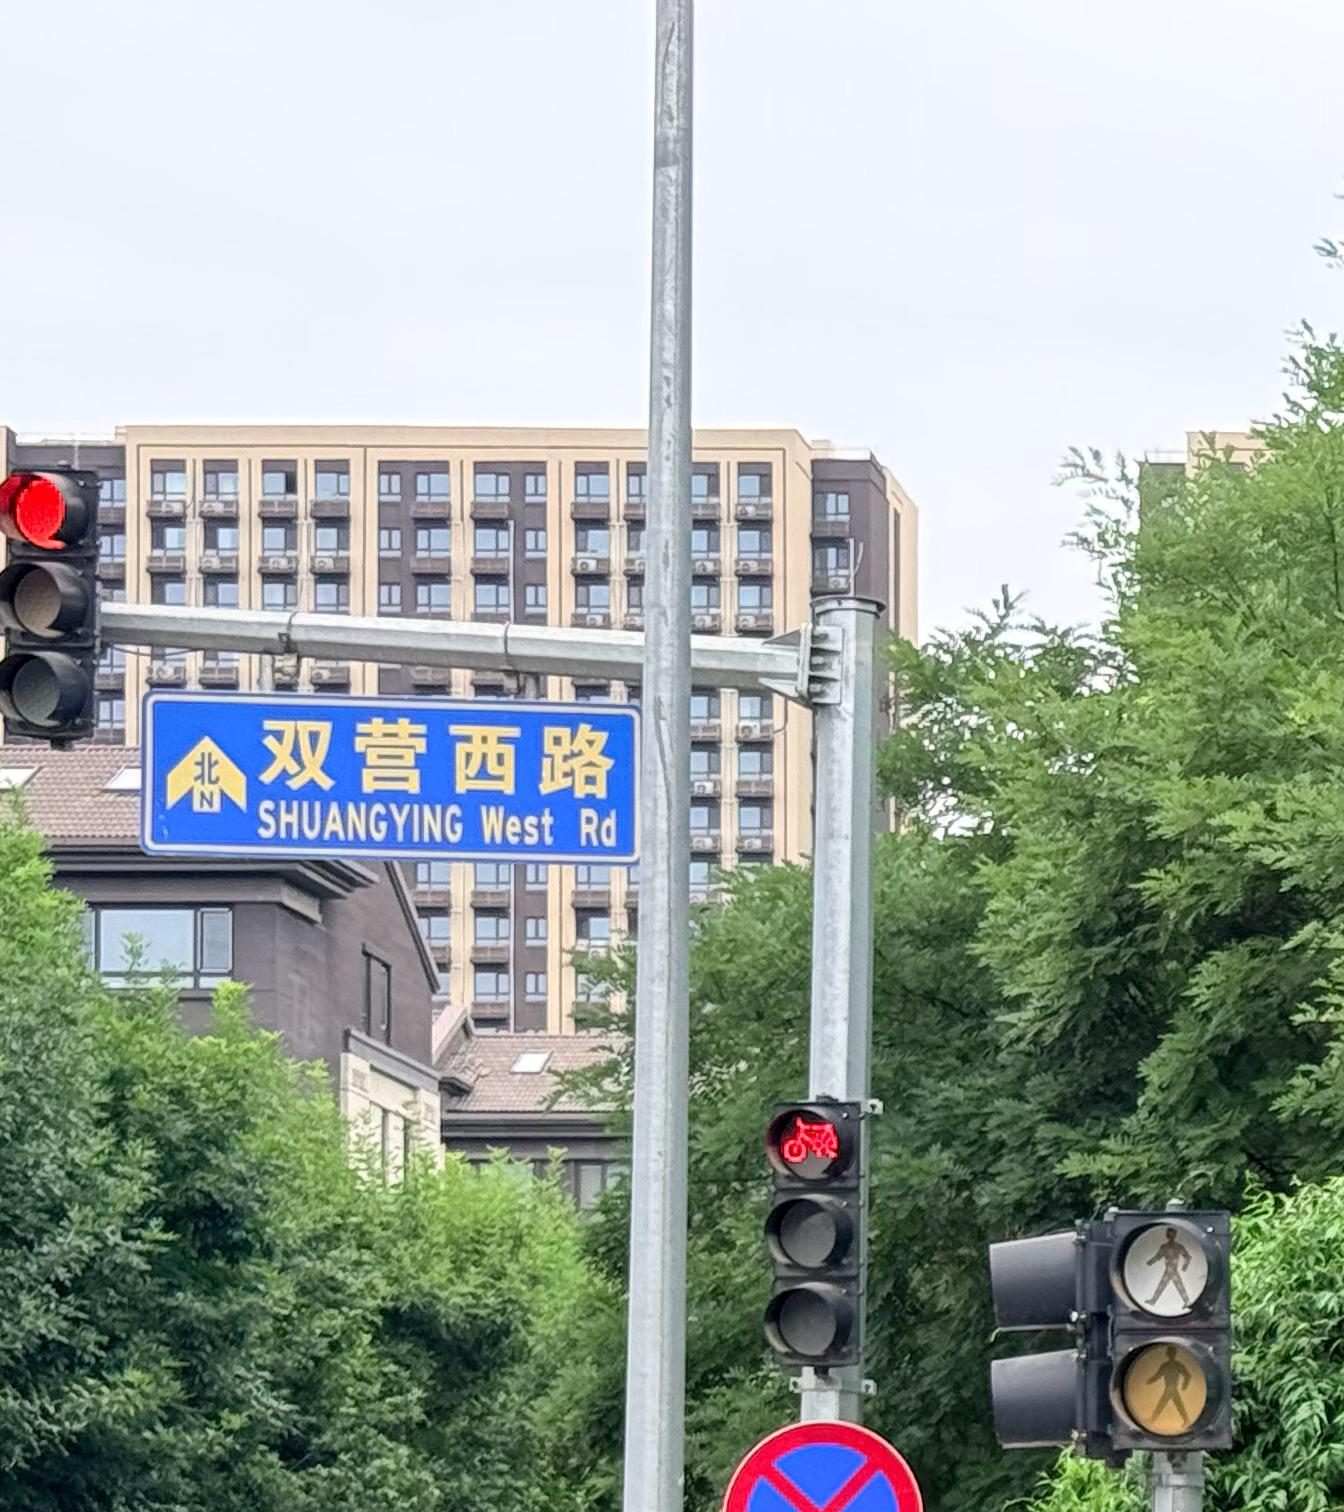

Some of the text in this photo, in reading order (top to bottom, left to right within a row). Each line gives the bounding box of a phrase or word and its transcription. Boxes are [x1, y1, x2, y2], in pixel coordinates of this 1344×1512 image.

[193, 751, 221, 787] 北
[257, 716, 614, 800] 双营西路
[199, 792, 214, 810] N
[257, 800, 617, 848] SHUANGYING West Rd
